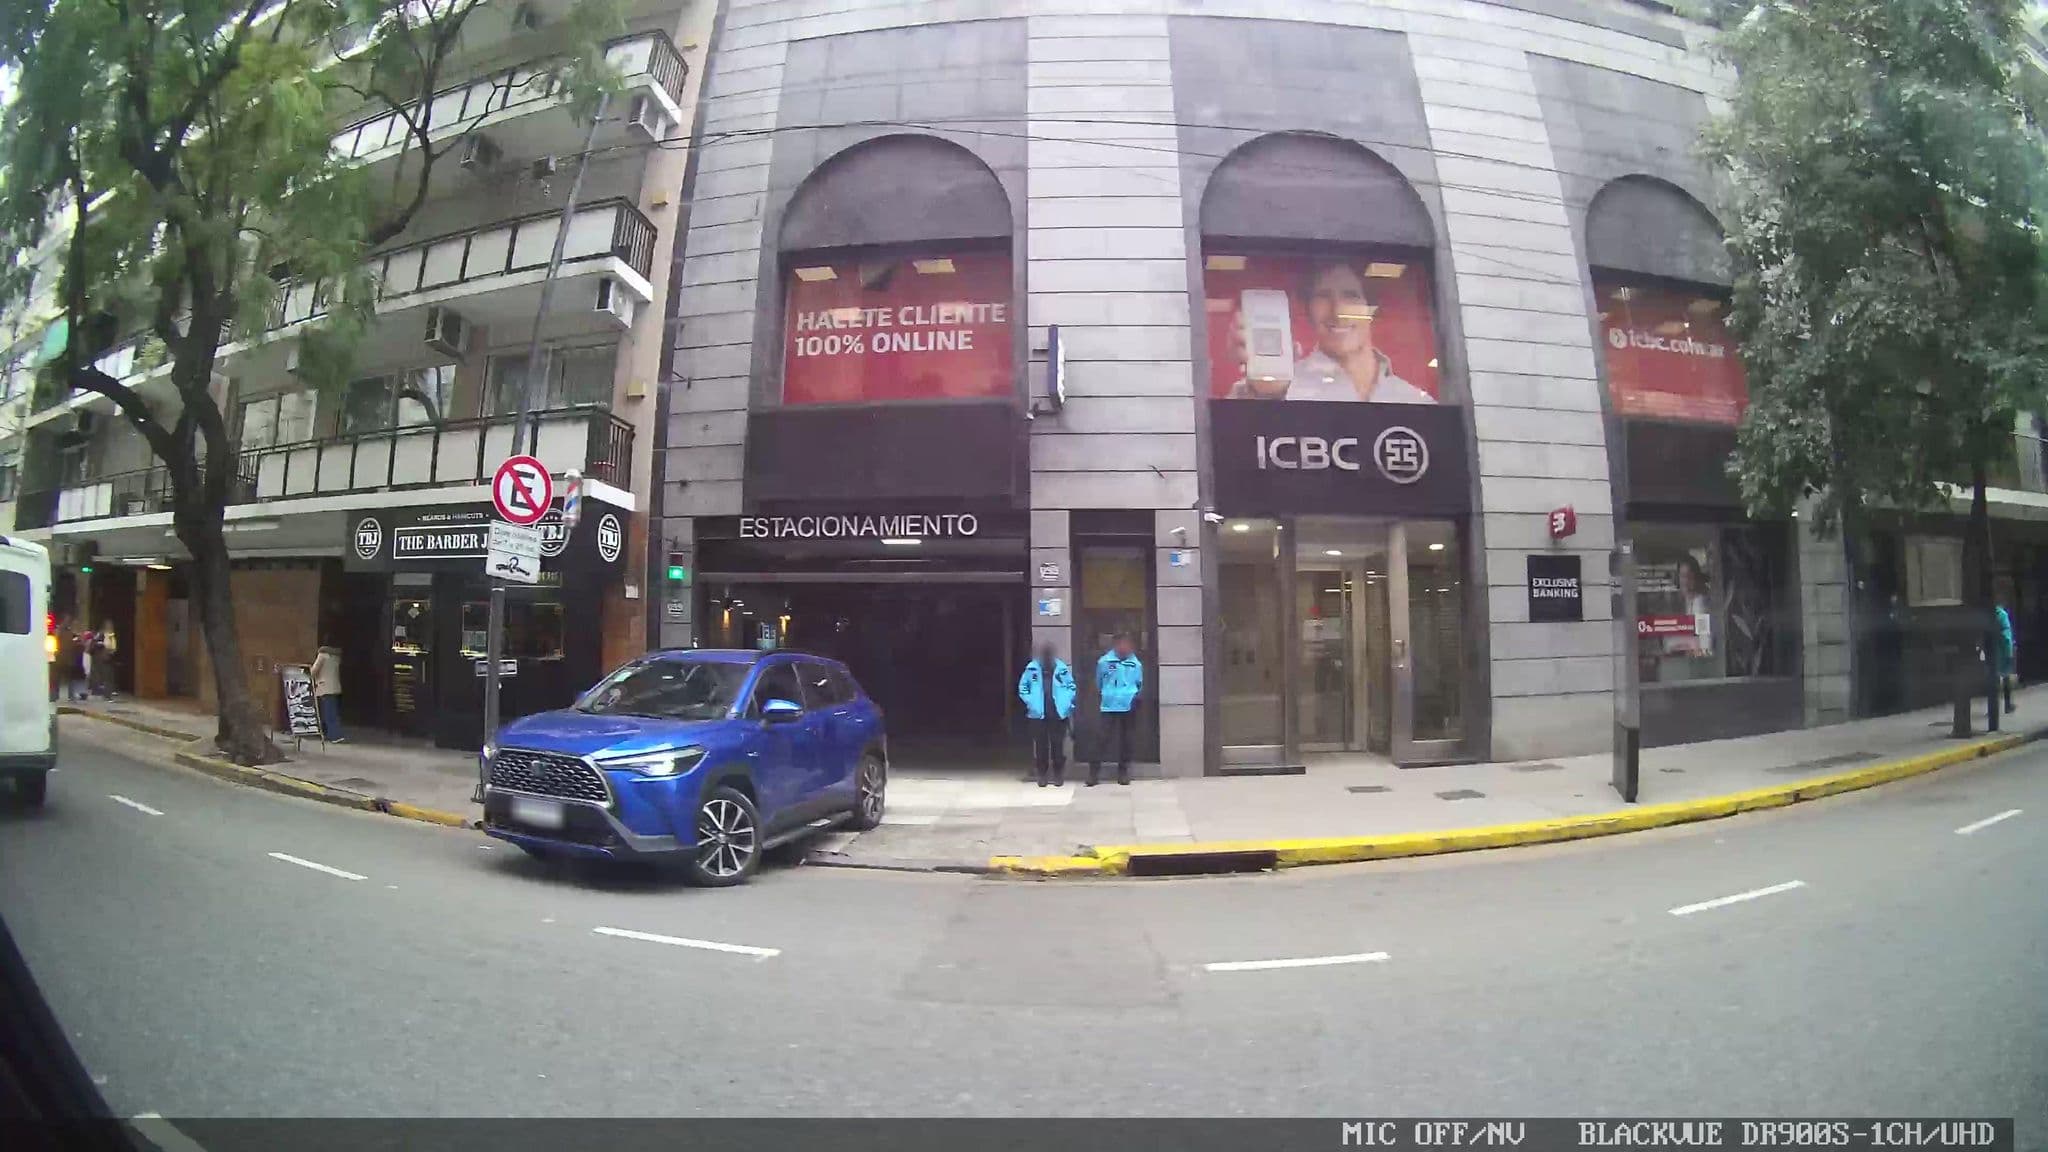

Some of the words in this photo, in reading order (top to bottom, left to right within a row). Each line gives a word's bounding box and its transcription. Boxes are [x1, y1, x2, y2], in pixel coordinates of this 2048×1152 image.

[796, 307, 893, 331] HACETE
[898, 303, 1007, 325] CLIENTE
[795, 334, 864, 357] 100%
[872, 330, 973, 354] ONLINE
[1256, 435, 1361, 470] ICBC
[537, 525, 564, 541] TBJ
[739, 513, 978, 538] ESTACIONAMIENTO
[358, 532, 378, 546] TBJ
[398, 535, 424, 550] THE
[427, 533, 479, 550] BARBER
[1532, 577, 1578, 588] EXCLUSIVE
[1533, 588, 1579, 598] BANKING
